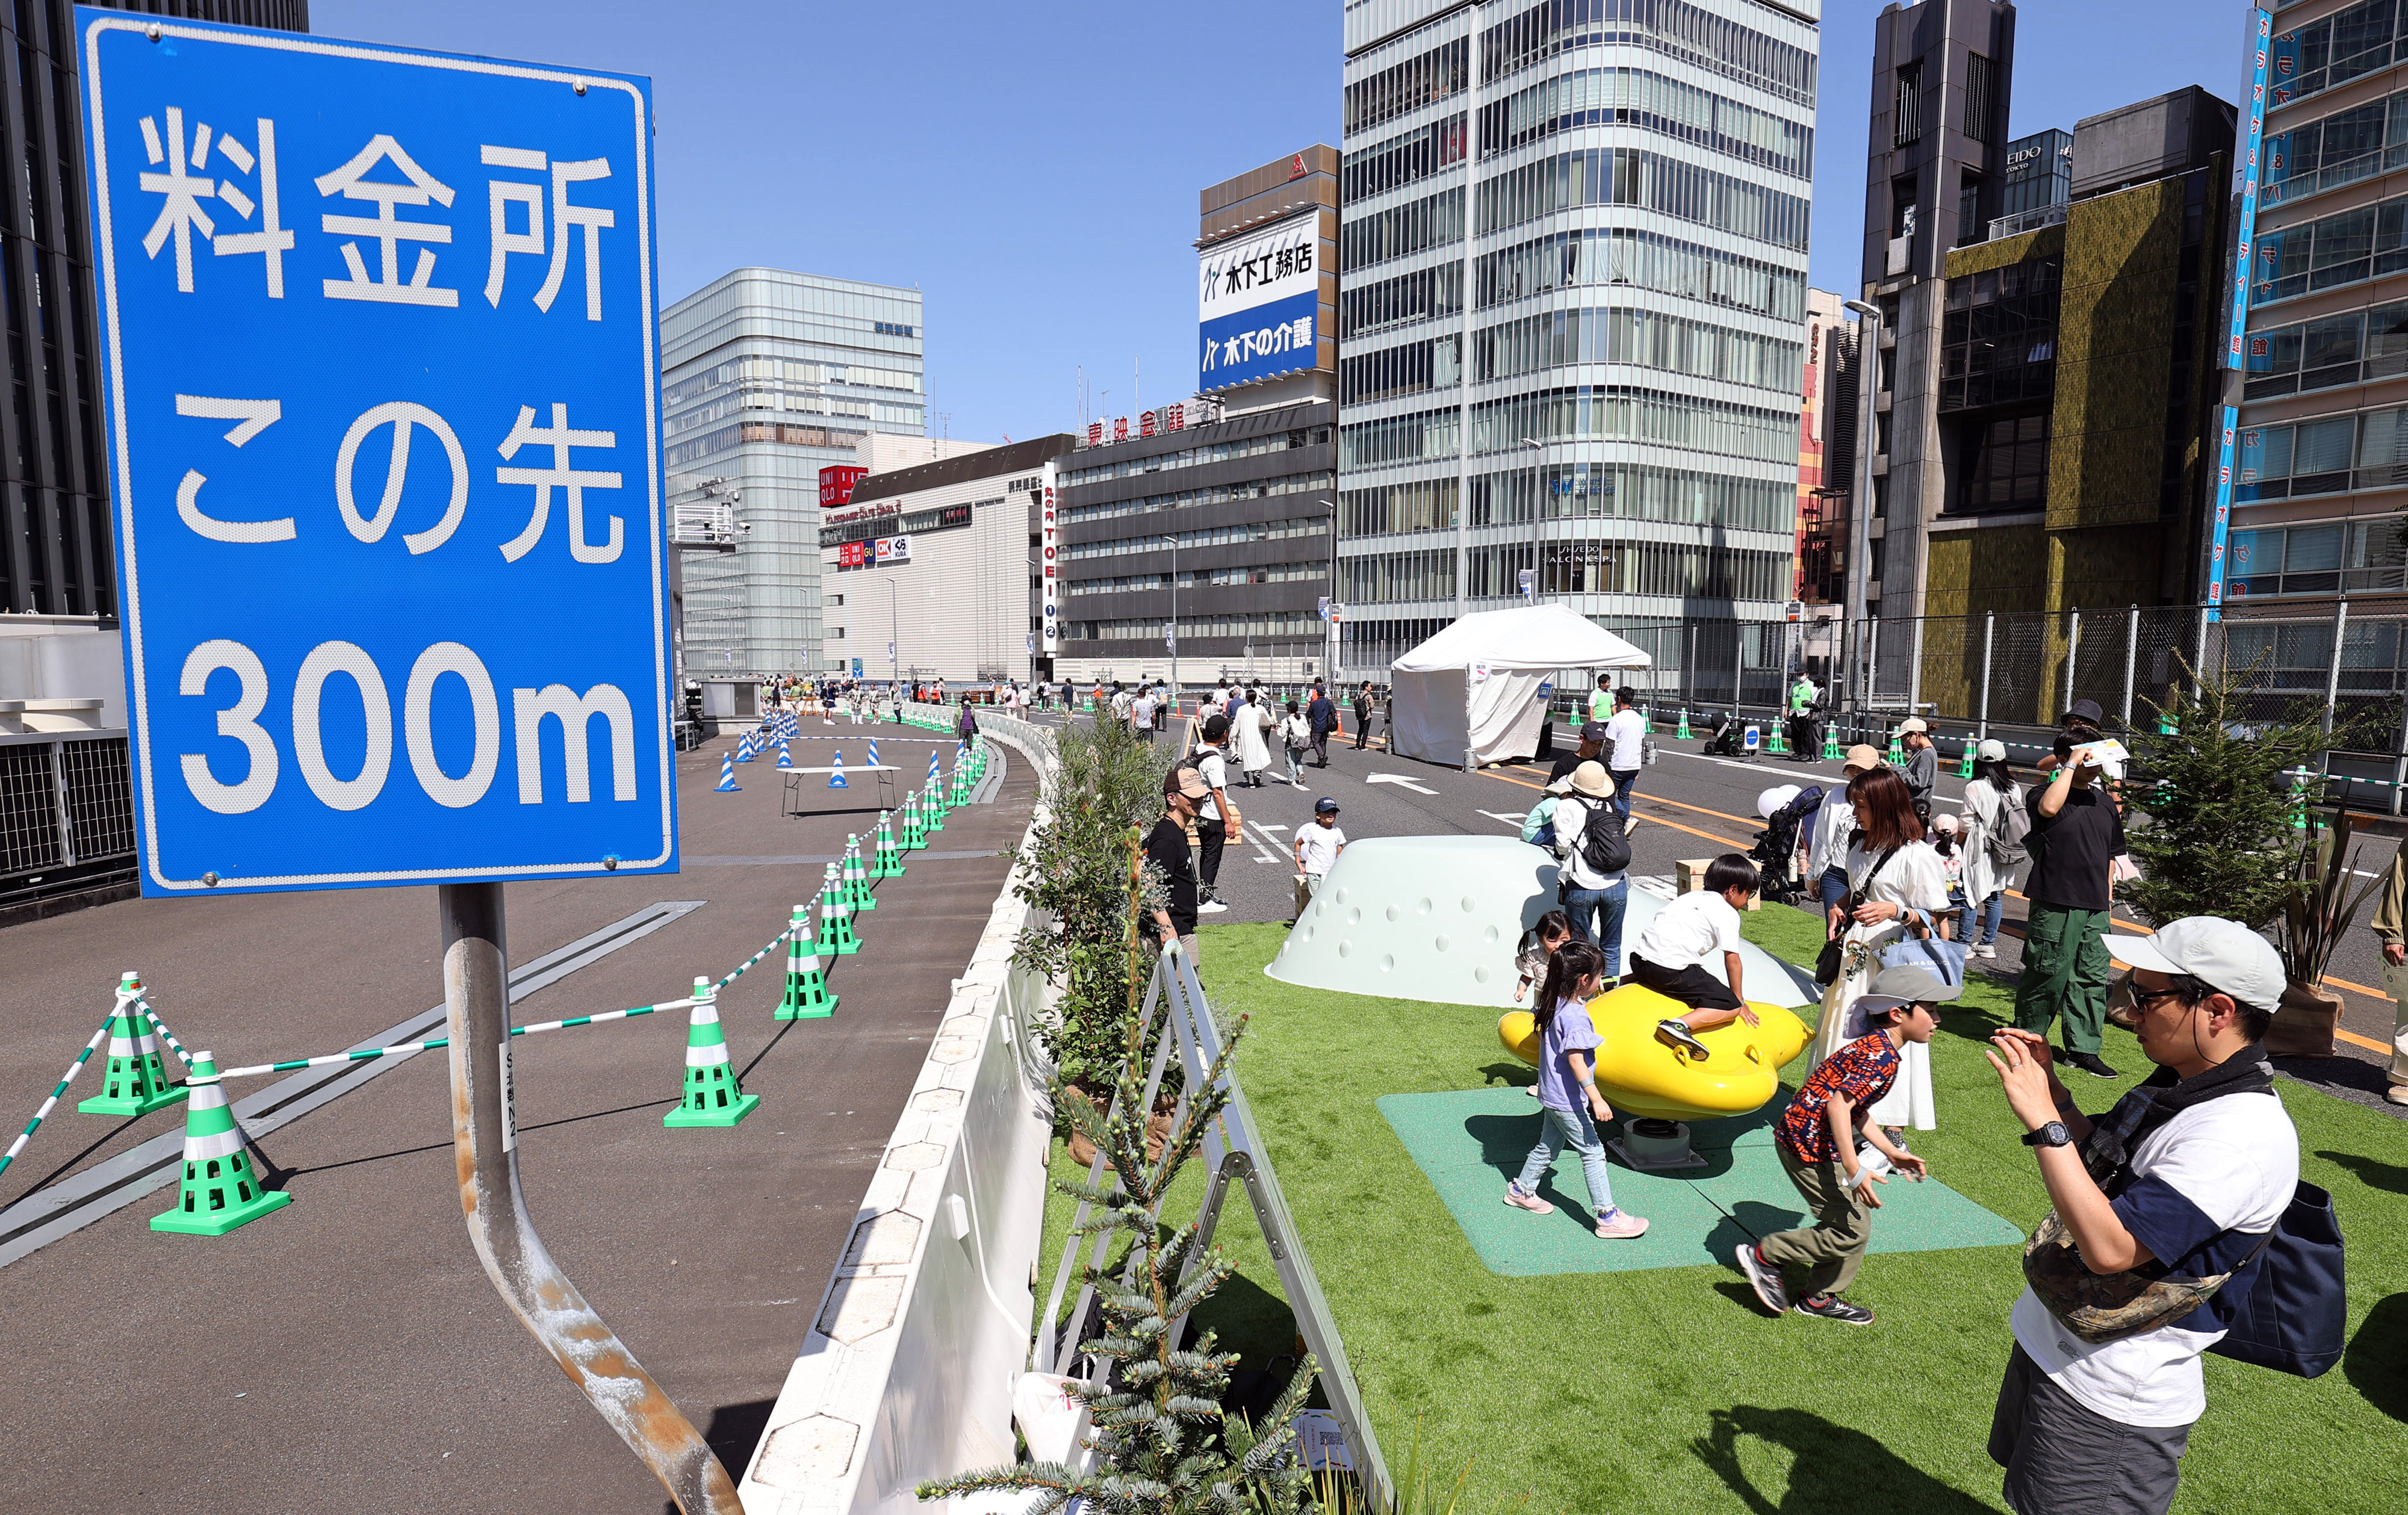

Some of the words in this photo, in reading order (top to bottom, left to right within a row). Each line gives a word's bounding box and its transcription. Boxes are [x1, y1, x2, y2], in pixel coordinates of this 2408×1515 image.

[2231, 17, 2270, 354] カラオケ&パーティー館
[140, 107, 613, 321] 料金所
[1226, 243, 1312, 296] 木下工務店
[1223, 316, 1312, 367] 木下の介護
[1088, 403, 1184, 447] 東映会館
[176, 394, 624, 564] この先
[821, 471, 834, 486] UNI
[821, 486, 835, 504] QLO
[2210, 427, 2233, 599] カラオケ館
[852, 554, 860, 563] QLO
[864, 547, 873, 557] GU
[878, 544, 890, 553] OK
[179, 639, 638, 814] 300m
